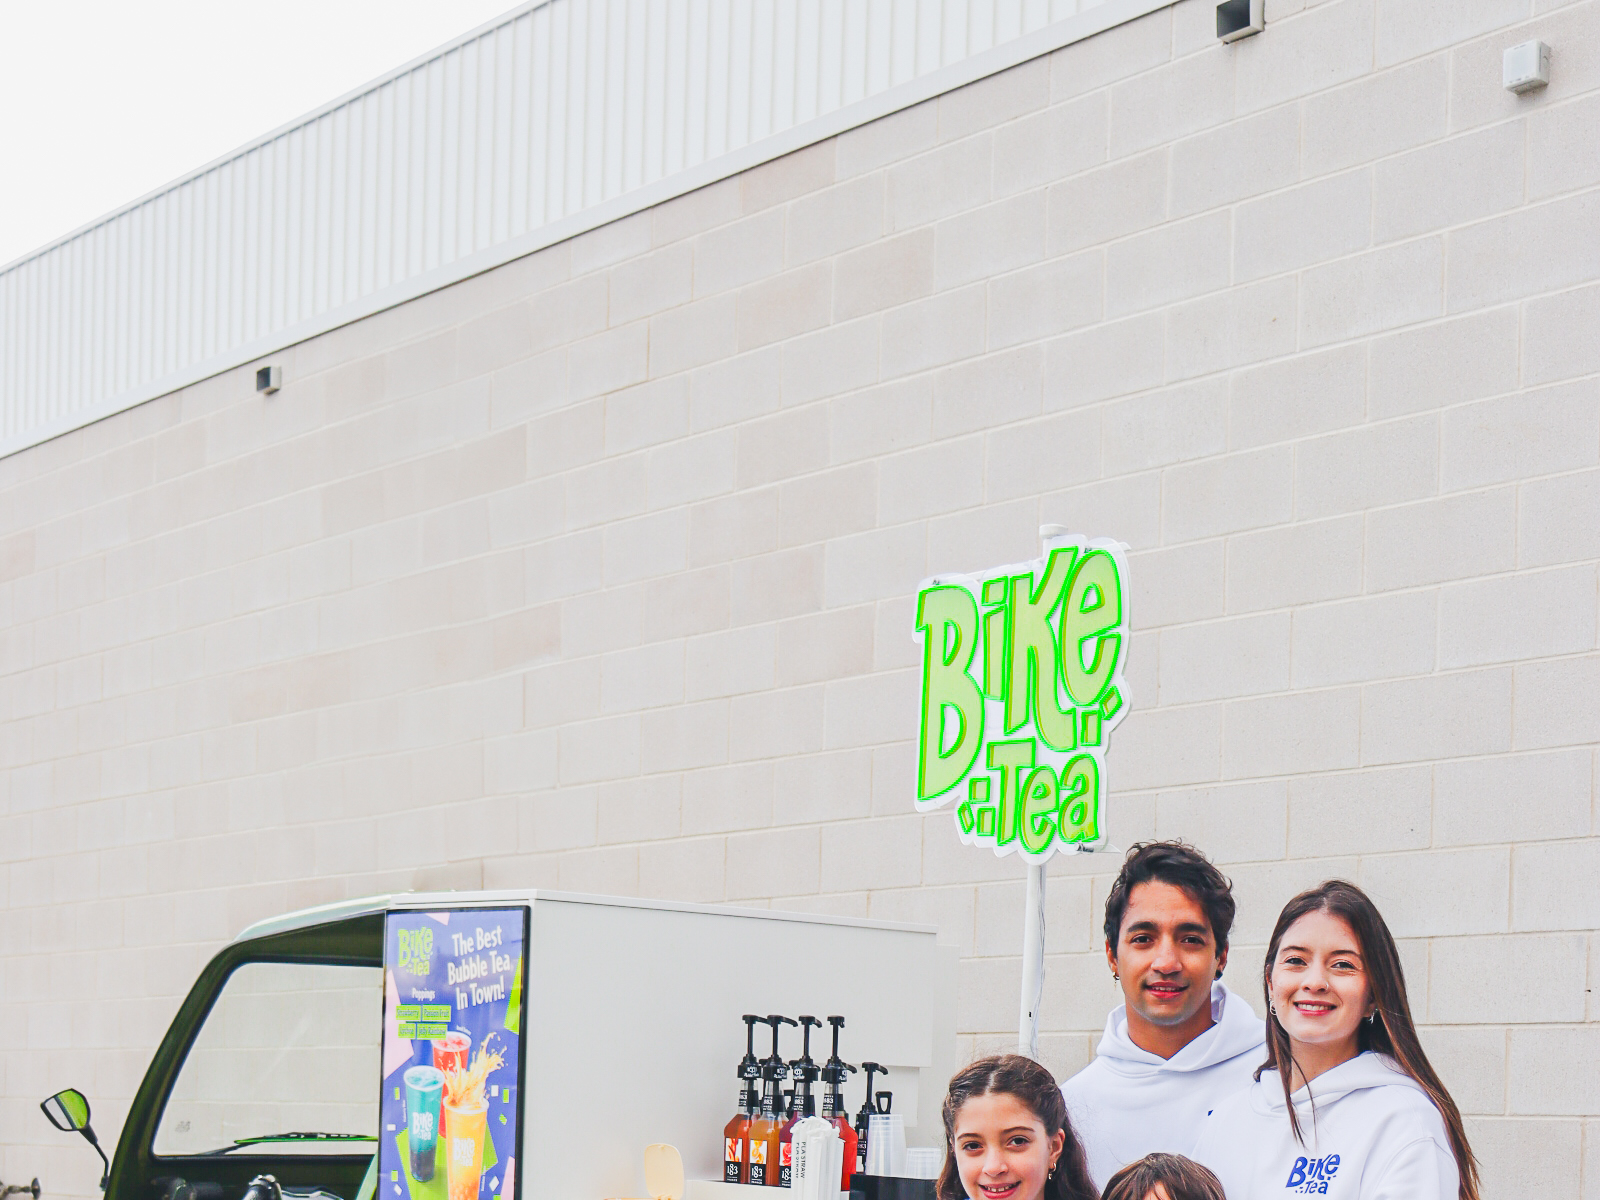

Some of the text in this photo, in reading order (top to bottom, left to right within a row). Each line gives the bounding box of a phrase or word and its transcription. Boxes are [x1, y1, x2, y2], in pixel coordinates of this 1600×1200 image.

[986, 737, 1100, 855] Tea
[452, 925, 502, 957] The Best
[411, 957, 430, 977] Tea
[447, 950, 511, 986] Bubble Tea
[411, 987, 436, 1002] Poppings
[456, 975, 506, 1011] In Town!
[420, 1129, 432, 1141] Tea
[1304, 1179, 1328, 1195] Tea
